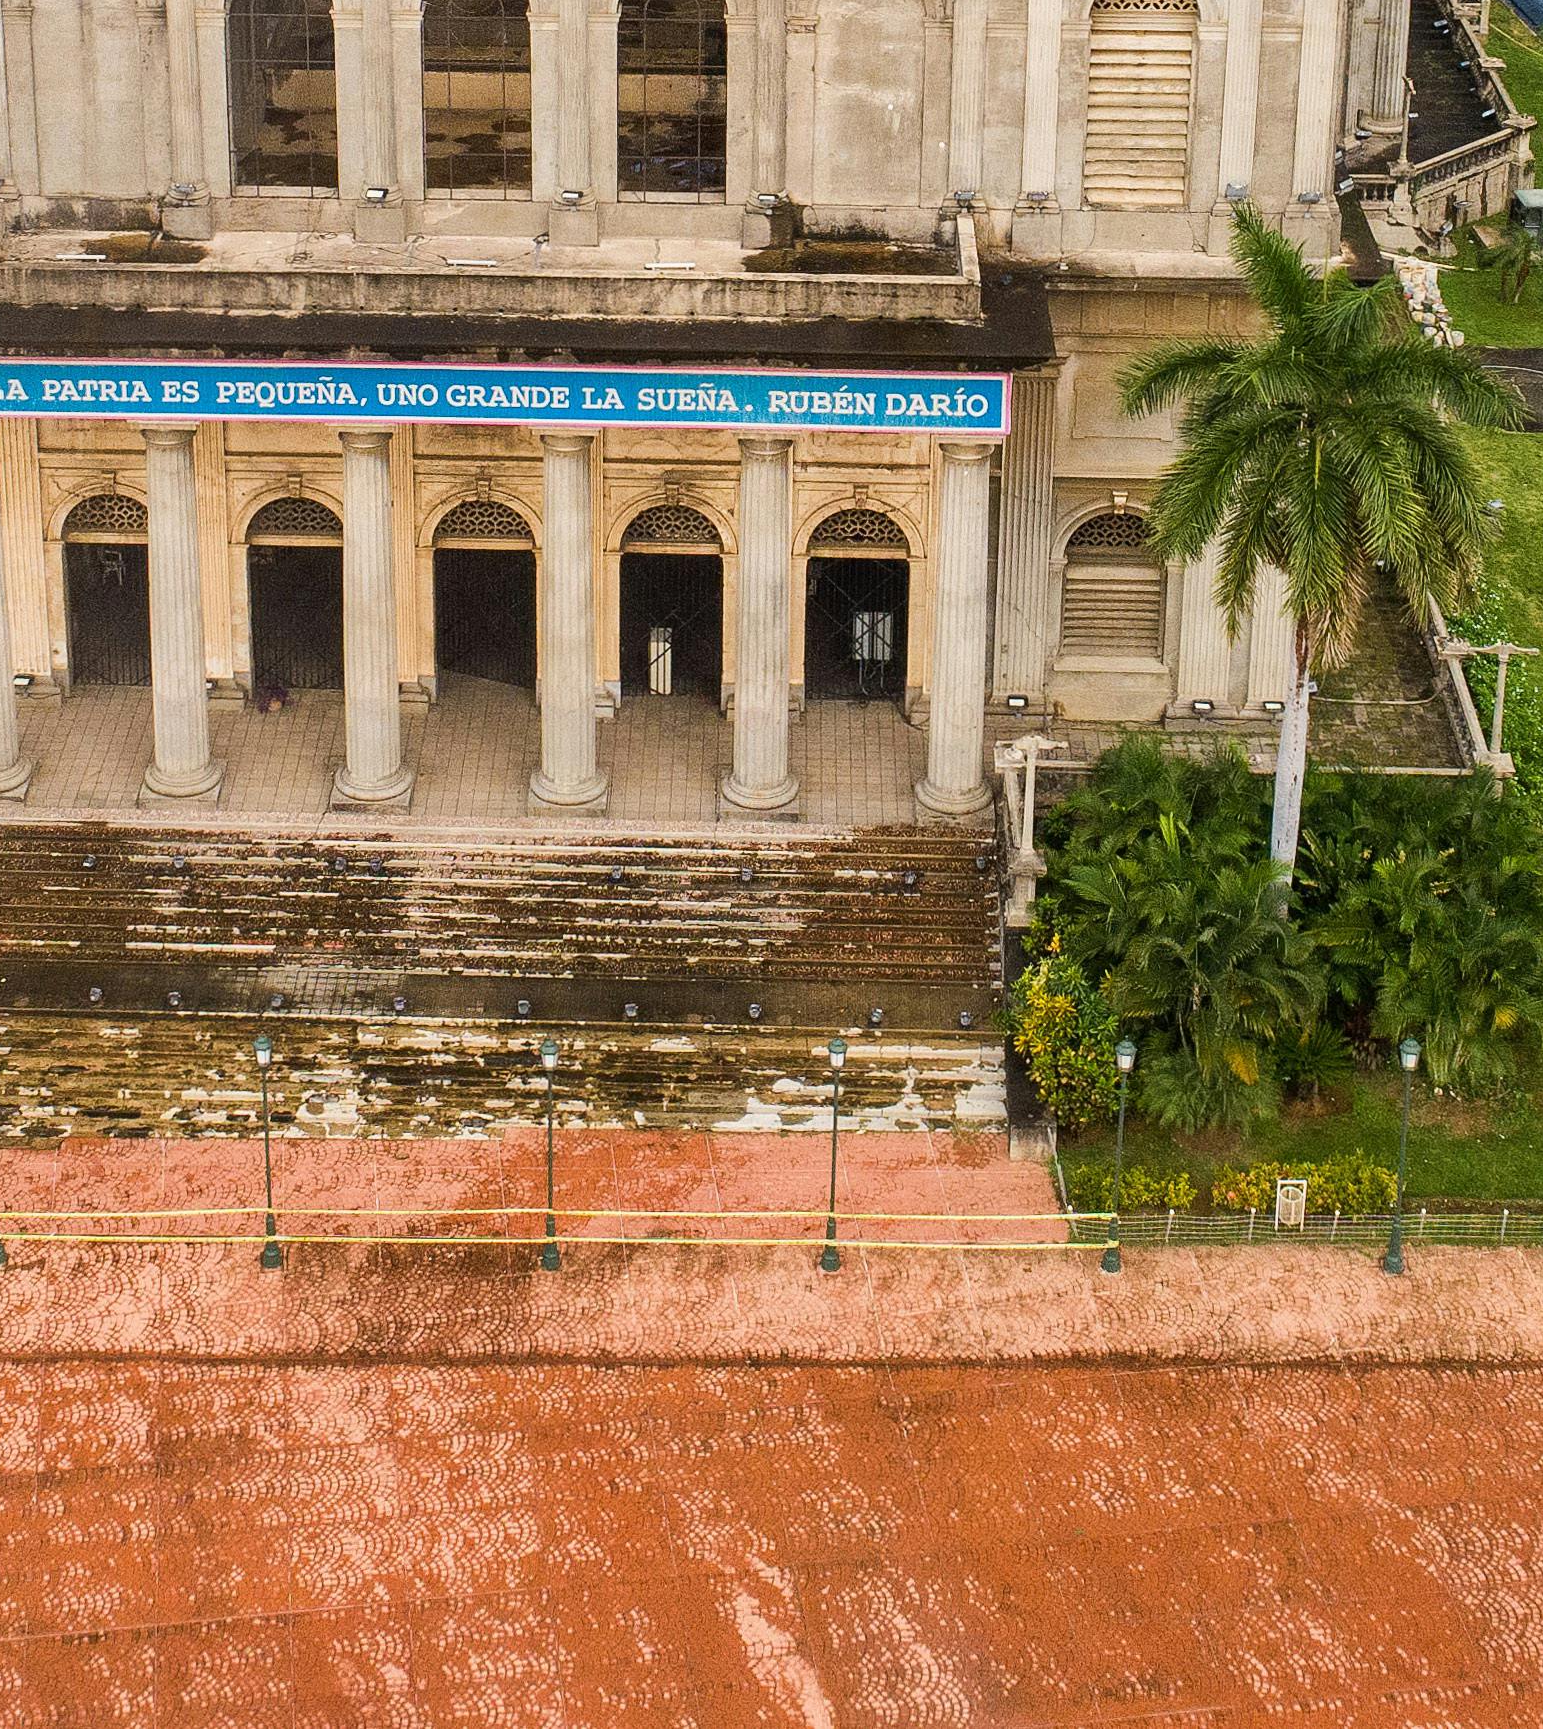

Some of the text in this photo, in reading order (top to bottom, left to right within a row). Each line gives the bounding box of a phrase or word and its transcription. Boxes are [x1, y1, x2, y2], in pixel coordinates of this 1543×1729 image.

[42, 379, 152, 403] PATRIA
[161, 380, 200, 403] ES
[216, 376, 367, 407] PEQUEÑA,
[376, 383, 439, 406] UNO
[446, 384, 569, 409] GRANDE
[581, 387, 625, 410] LA
[768, 385, 878, 416] RUBÉN
[885, 387, 989, 417] DARÍO
